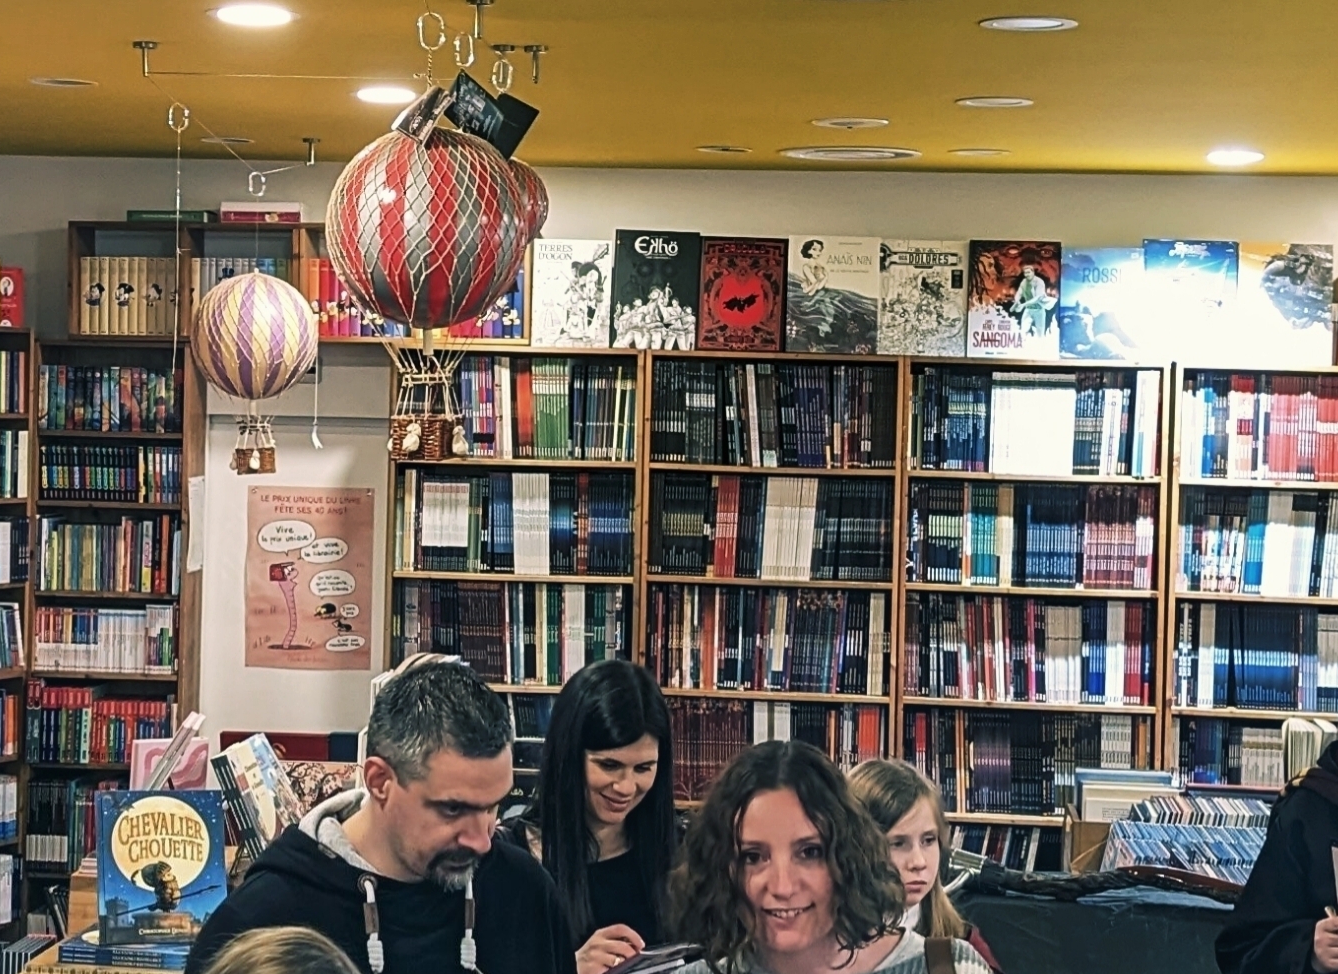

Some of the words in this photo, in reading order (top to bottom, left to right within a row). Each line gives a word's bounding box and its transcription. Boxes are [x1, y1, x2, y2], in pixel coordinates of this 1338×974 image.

[538, 244, 573, 252] TERRES
[972, 331, 1022, 348] SANGOMA
[117, 812, 205, 845] CHEVALIER
[128, 838, 203, 863] CHOUETTE
